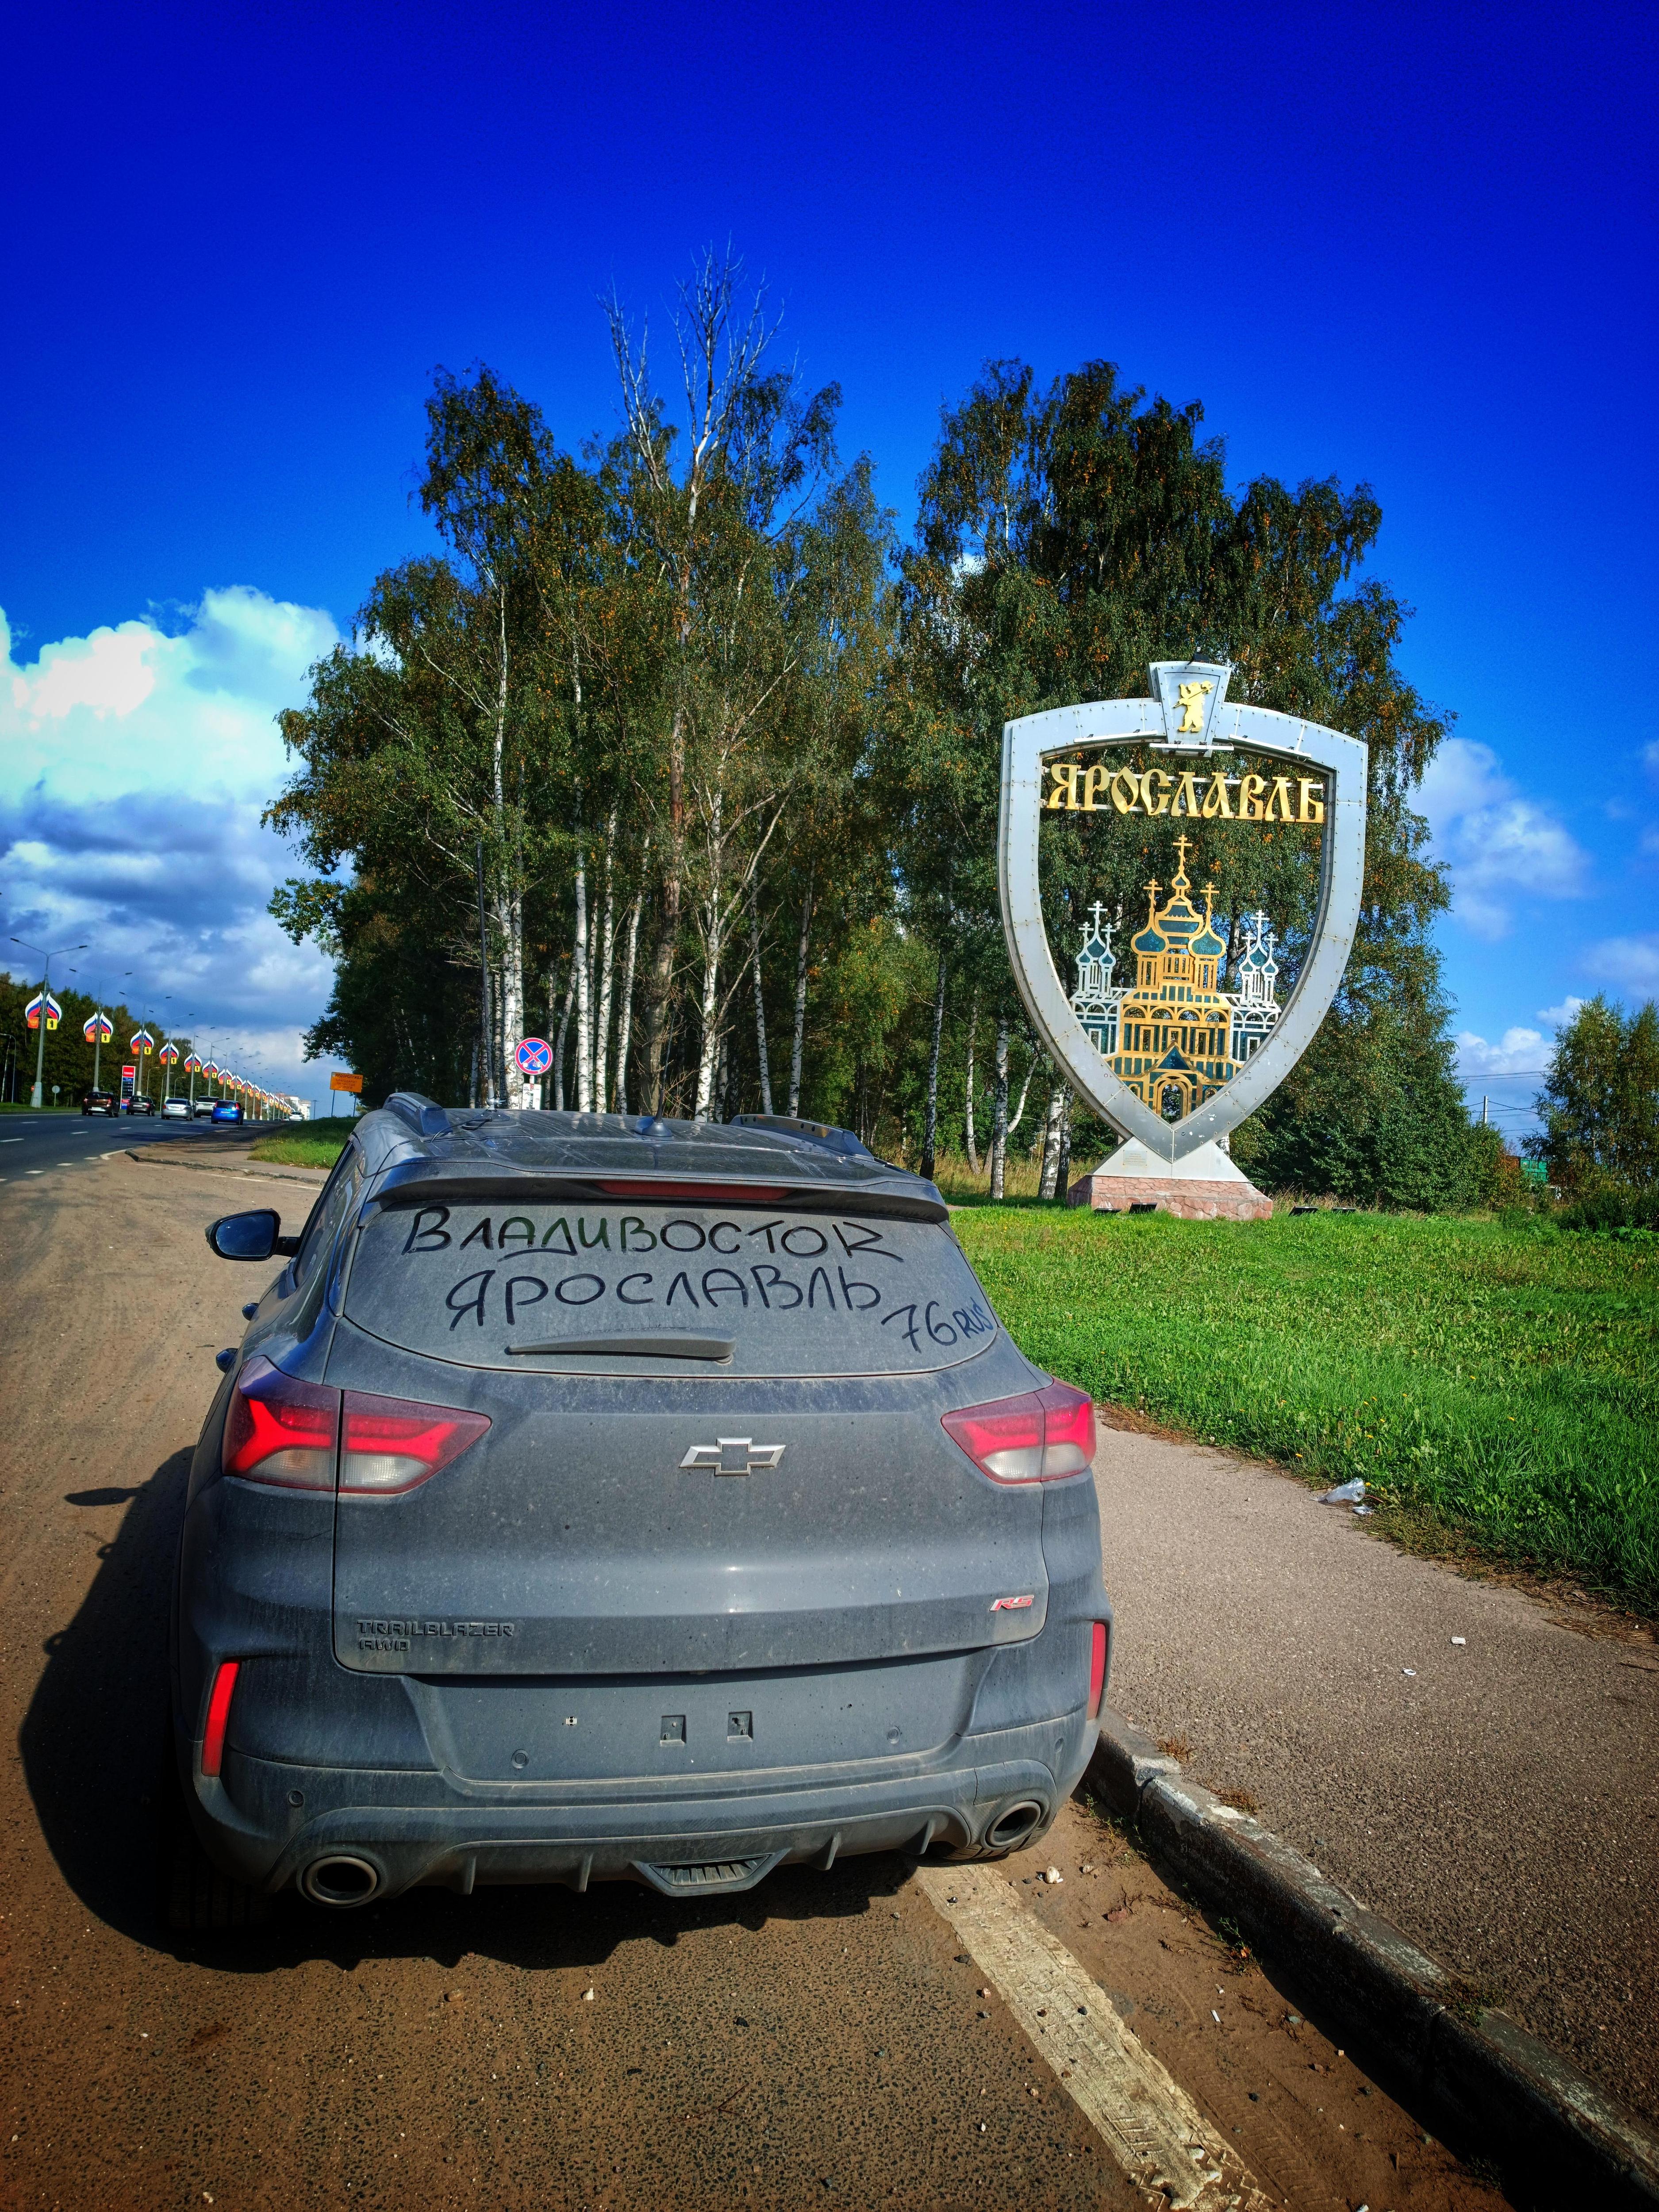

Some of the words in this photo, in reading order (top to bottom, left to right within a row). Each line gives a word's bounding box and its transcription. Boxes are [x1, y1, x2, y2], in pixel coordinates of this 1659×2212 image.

[1047, 764, 1325, 824] ЯРОСЛАВЛЬ
[445, 1265, 881, 1331] ЯРОСЛАВЛЬ
[989, 1595, 1034, 1612] RS
[357, 1619, 515, 1637] TRAILBLAZER
[359, 1638, 411, 1651] AWD
